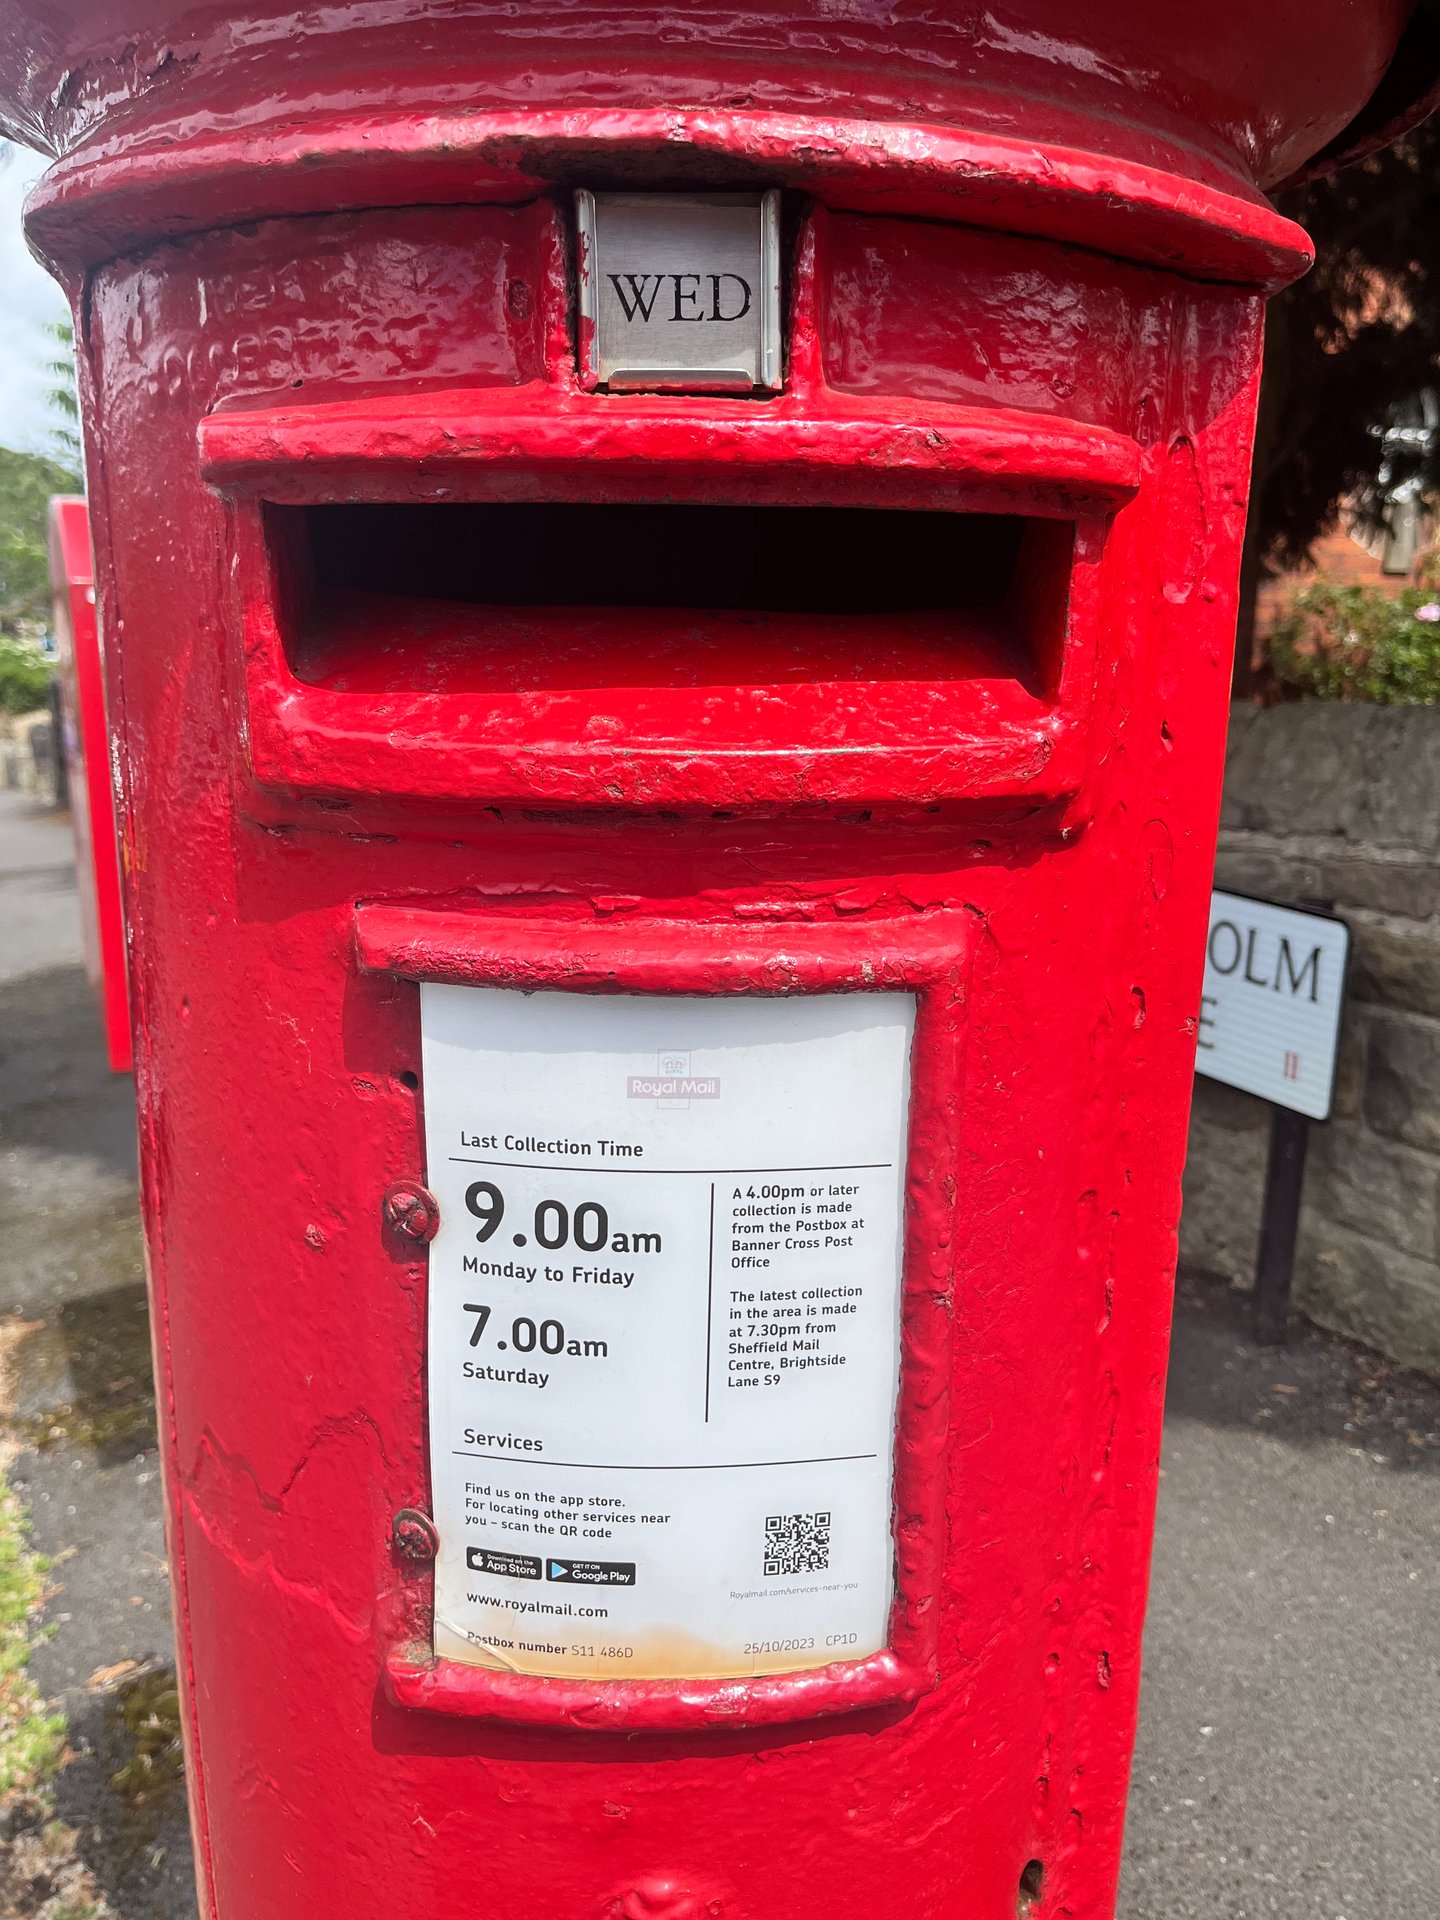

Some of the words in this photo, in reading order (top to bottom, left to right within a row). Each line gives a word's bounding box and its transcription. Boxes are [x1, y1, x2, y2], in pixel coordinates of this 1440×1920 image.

[606, 273, 752, 322] WED
[1208, 920, 1323, 1003] OLM
[632, 1080, 676, 1096] Royal
[681, 1080, 715, 1094] Mail
[461, 1131, 498, 1149] Last
[505, 1135, 591, 1155] Collection
[597, 1140, 643, 1157] Time
[733, 1188, 742, 1199] A
[746, 1185, 804, 1201] 4.00pm
[810, 1188, 824, 1196] or
[829, 1184, 859, 1196] later
[465, 1181, 661, 1253] 9.00am
[733, 1204, 796, 1216] collection
[801, 1203, 811, 1214] is
[817, 1201, 852, 1214] made
[732, 1222, 764, 1234] from
[769, 1221, 790, 1233] the
[796, 1219, 846, 1232] Postbox
[851, 1218, 864, 1229] at
[732, 1240, 781, 1251] Banner
[785, 1238, 820, 1249] Cross
[825, 1236, 853, 1247] Post
[731, 1256, 770, 1268] Office
[463, 1255, 537, 1283] Monday
[544, 1266, 564, 1282] to
[573, 1266, 634, 1288] Friday
[730, 1291, 755, 1302] The
[760, 1290, 797, 1301] latest
[802, 1285, 862, 1299] collection
[730, 1308, 741, 1319] in
[747, 1307, 768, 1319] the
[773, 1308, 801, 1318] area
[807, 1304, 817, 1316] is
[822, 1302, 856, 1315] made
[463, 1303, 607, 1357] 7.00am
[729, 1327, 743, 1337] at
[747, 1324, 800, 1338] 7.30pm
[805, 1323, 836, 1334] from
[729, 1341, 788, 1354] Sheffield
[793, 1339, 820, 1351] Mail
[729, 1360, 774, 1371] Centre,
[780, 1354, 846, 1369] Brightside
[463, 1362, 549, 1388] Saturday
[728, 1376, 759, 1387] Lane
[764, 1374, 780, 1385] S9
[464, 1428, 543, 1451] Services
[465, 1482, 491, 1496] Find
[496, 1489, 510, 1498] us
[515, 1492, 529, 1501] on
[534, 1492, 555, 1503] the
[560, 1496, 583, 1507] app
[588, 1497, 625, 1507] store.
[466, 1498, 485, 1510] For
[489, 1501, 539, 1519] locating
[544, 1509, 579, 1520] other
[583, 1512, 636, 1523] services
[641, 1515, 671, 1523] near
[465, 1515, 487, 1526] you
[501, 1521, 529, 1532] scan
[533, 1523, 555, 1534] the
[560, 1525, 577, 1536] QR
[583, 1527, 612, 1538] code
[486, 1553, 514, 1563] Download
[486, 1560, 507, 1572] App
[508, 1564, 537, 1575] Store
[572, 1569, 608, 1582] Google
[610, 1571, 631, 1583] Play
[467, 1593, 608, 1617] www.royalmail.com
[519, 1641, 567, 1654] number
[571, 1645, 595, 1657] S11
[600, 1647, 634, 1658] 486D
[744, 1637, 815, 1654] 25/10/2023
[825, 1632, 858, 1646] CP1D
